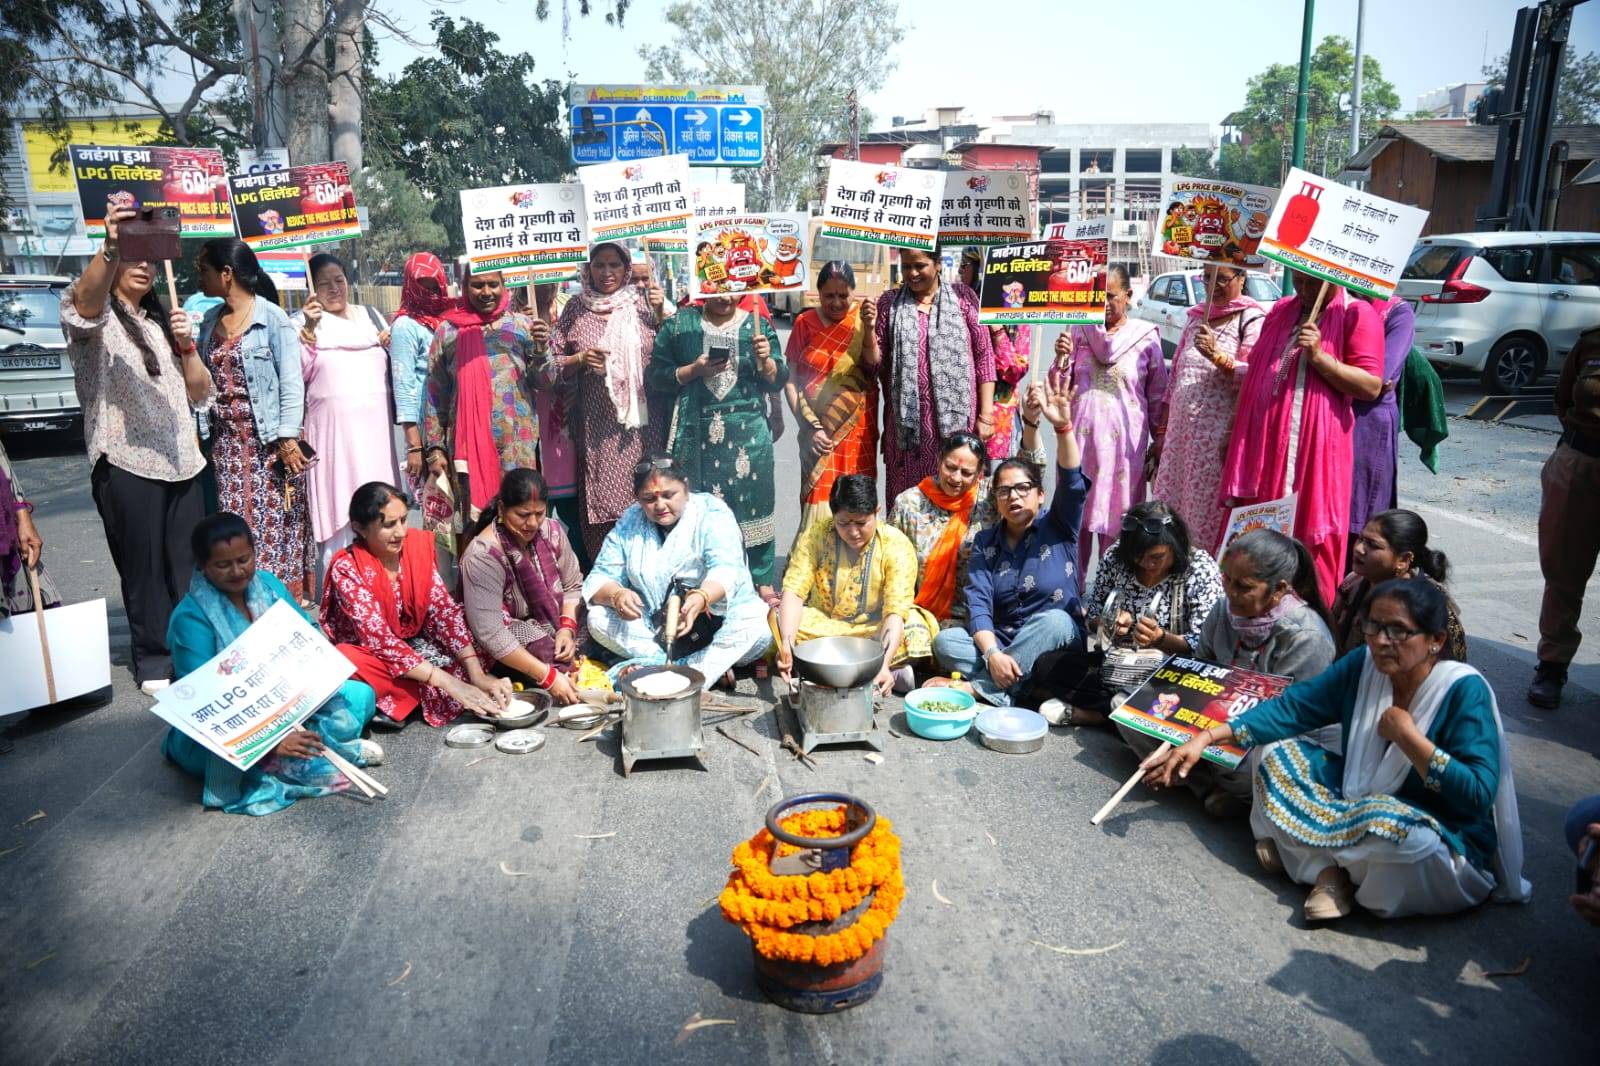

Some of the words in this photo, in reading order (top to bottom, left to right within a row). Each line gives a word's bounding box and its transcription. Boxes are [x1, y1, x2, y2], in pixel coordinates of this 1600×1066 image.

[623, 127, 640, 146] पुलिस
[724, 127, 743, 142] विकास
[745, 131, 758, 142] भवन
[77, 148, 119, 162] महंगा
[120, 149, 150, 164] हुआ
[599, 147, 611, 157] Hall
[618, 146, 635, 157] Police
[697, 146, 716, 157] Chowk
[722, 146, 737, 157] Vikas
[738, 146, 760, 157] Bhawan
[77, 167, 107, 180] LPG
[109, 165, 163, 181] सिलेंडर
[234, 174, 266, 188] महंगा
[267, 172, 290, 187] हुआ
[593, 190, 612, 204] देश
[614, 186, 629, 201] की
[631, 182, 663, 202] गृहणी
[667, 179, 681, 194] को
[1177, 183, 1190, 191] LPG
[234, 192, 258, 205] LPG
[258, 186, 300, 201] सिलेंडर
[837, 185, 856, 201] देश
[859, 189, 875, 204] की
[879, 192, 913, 211] गृहणी
[916, 195, 930, 211] को
[593, 204, 629, 222] महंगाई
[632, 202, 642, 217] से
[645, 200, 671, 214] न्याय
[675, 196, 687, 210] दो
[958, 195, 972, 210] की
[975, 195, 1005, 214] गृहणी
[1008, 196, 1021, 211] को
[286, 214, 305, 227] REDUCE
[306, 213, 315, 225] THE
[316, 212, 329, 223] PRICE
[475, 215, 495, 231] देश
[499, 213, 515, 229] की
[519, 210, 554, 230] गृहणी
[558, 209, 575, 225] को
[700, 222, 713, 231] LPG
[715, 219, 733, 227] PRICE
[744, 218, 766, 226] AGAIN!
[830, 204, 870, 223] महंगाई
[874, 208, 884, 224] से
[888, 213, 915, 227] न्याय
[919, 214, 933, 229] दो
[973, 213, 983, 228] से
[987, 216, 1012, 228] न्याय
[1014, 214, 1026, 229] दो
[1388, 214, 1399, 226] पर
[473, 232, 513, 251] महंगाई
[518, 230, 528, 246] से
[533, 230, 564, 244] न्याय
[567, 227, 580, 242] दो
[992, 246, 1020, 258] महंगा
[1022, 244, 1046, 259] हुआ
[986, 263, 1008, 275] LPG
[1010, 259, 1053, 273] सिलेंडर
[1028, 291, 1048, 302] REDUCE
[1049, 291, 1058, 302] THE
[1059, 291, 1075, 302] PRICE
[1076, 291, 1086, 302] RISE
[1087, 291, 1094, 302] OF
[1095, 291, 1106, 302] LPG
[1172, 656, 1201, 674] महंगा
[1200, 664, 1231, 679] हुआ
[1155, 668, 1180, 683] LPG
[1179, 672, 1225, 697] सिलेंडर
[191, 701, 220, 724] अगर
[214, 685, 248, 711] LPG
[210, 722, 227, 737] तो
[224, 711, 248, 731] क्या
